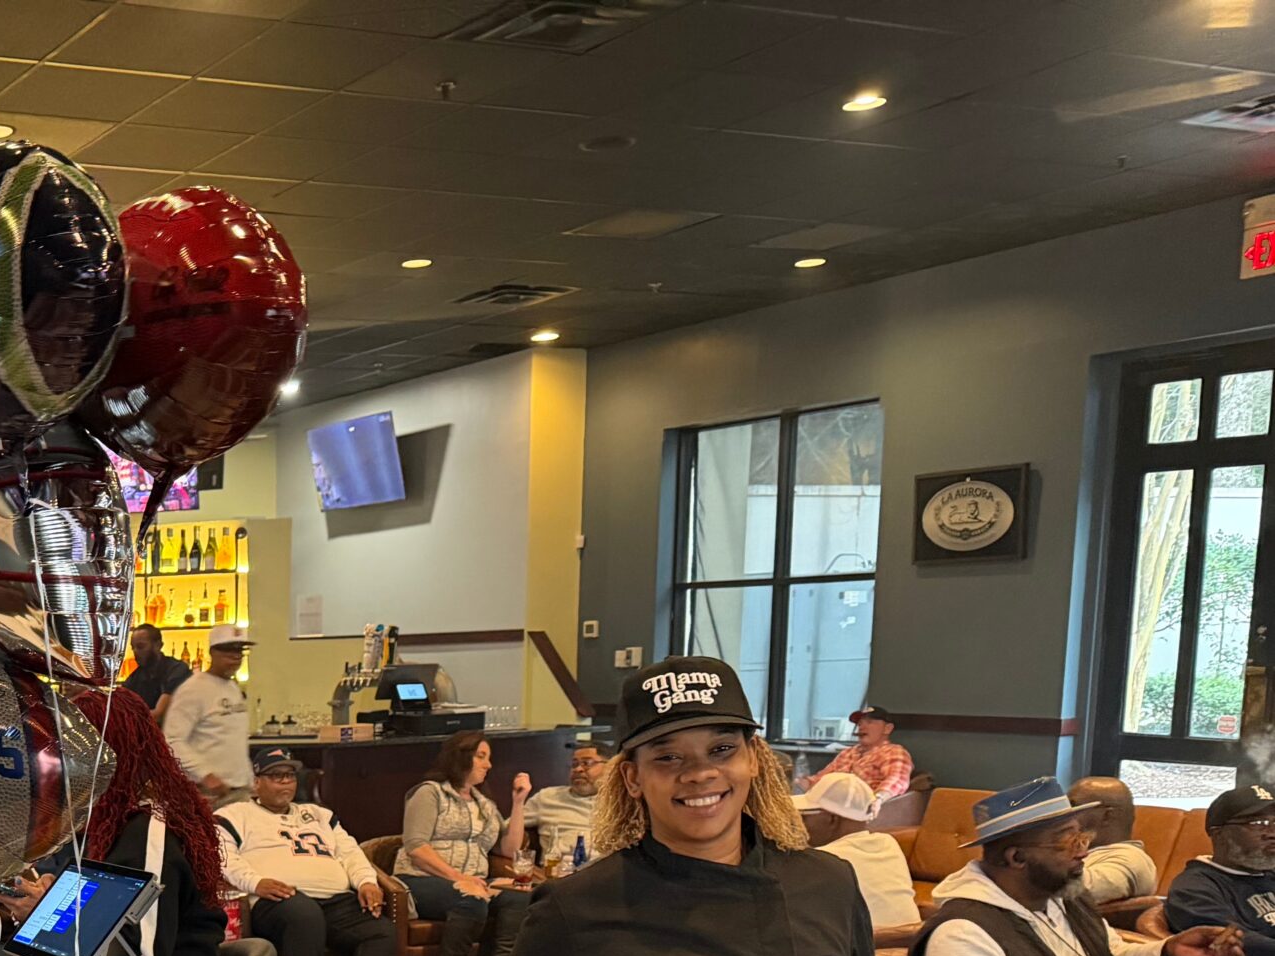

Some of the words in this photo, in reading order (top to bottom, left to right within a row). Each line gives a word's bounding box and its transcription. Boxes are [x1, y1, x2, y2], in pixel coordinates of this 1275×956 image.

[941, 492, 953, 505] LA
[954, 487, 995, 502] AURORA
[642, 672, 722, 692] Mama
[653, 688, 718, 713] Gang
[1250, 784, 1273, 800] LA
[279, 829, 333, 857] 12
